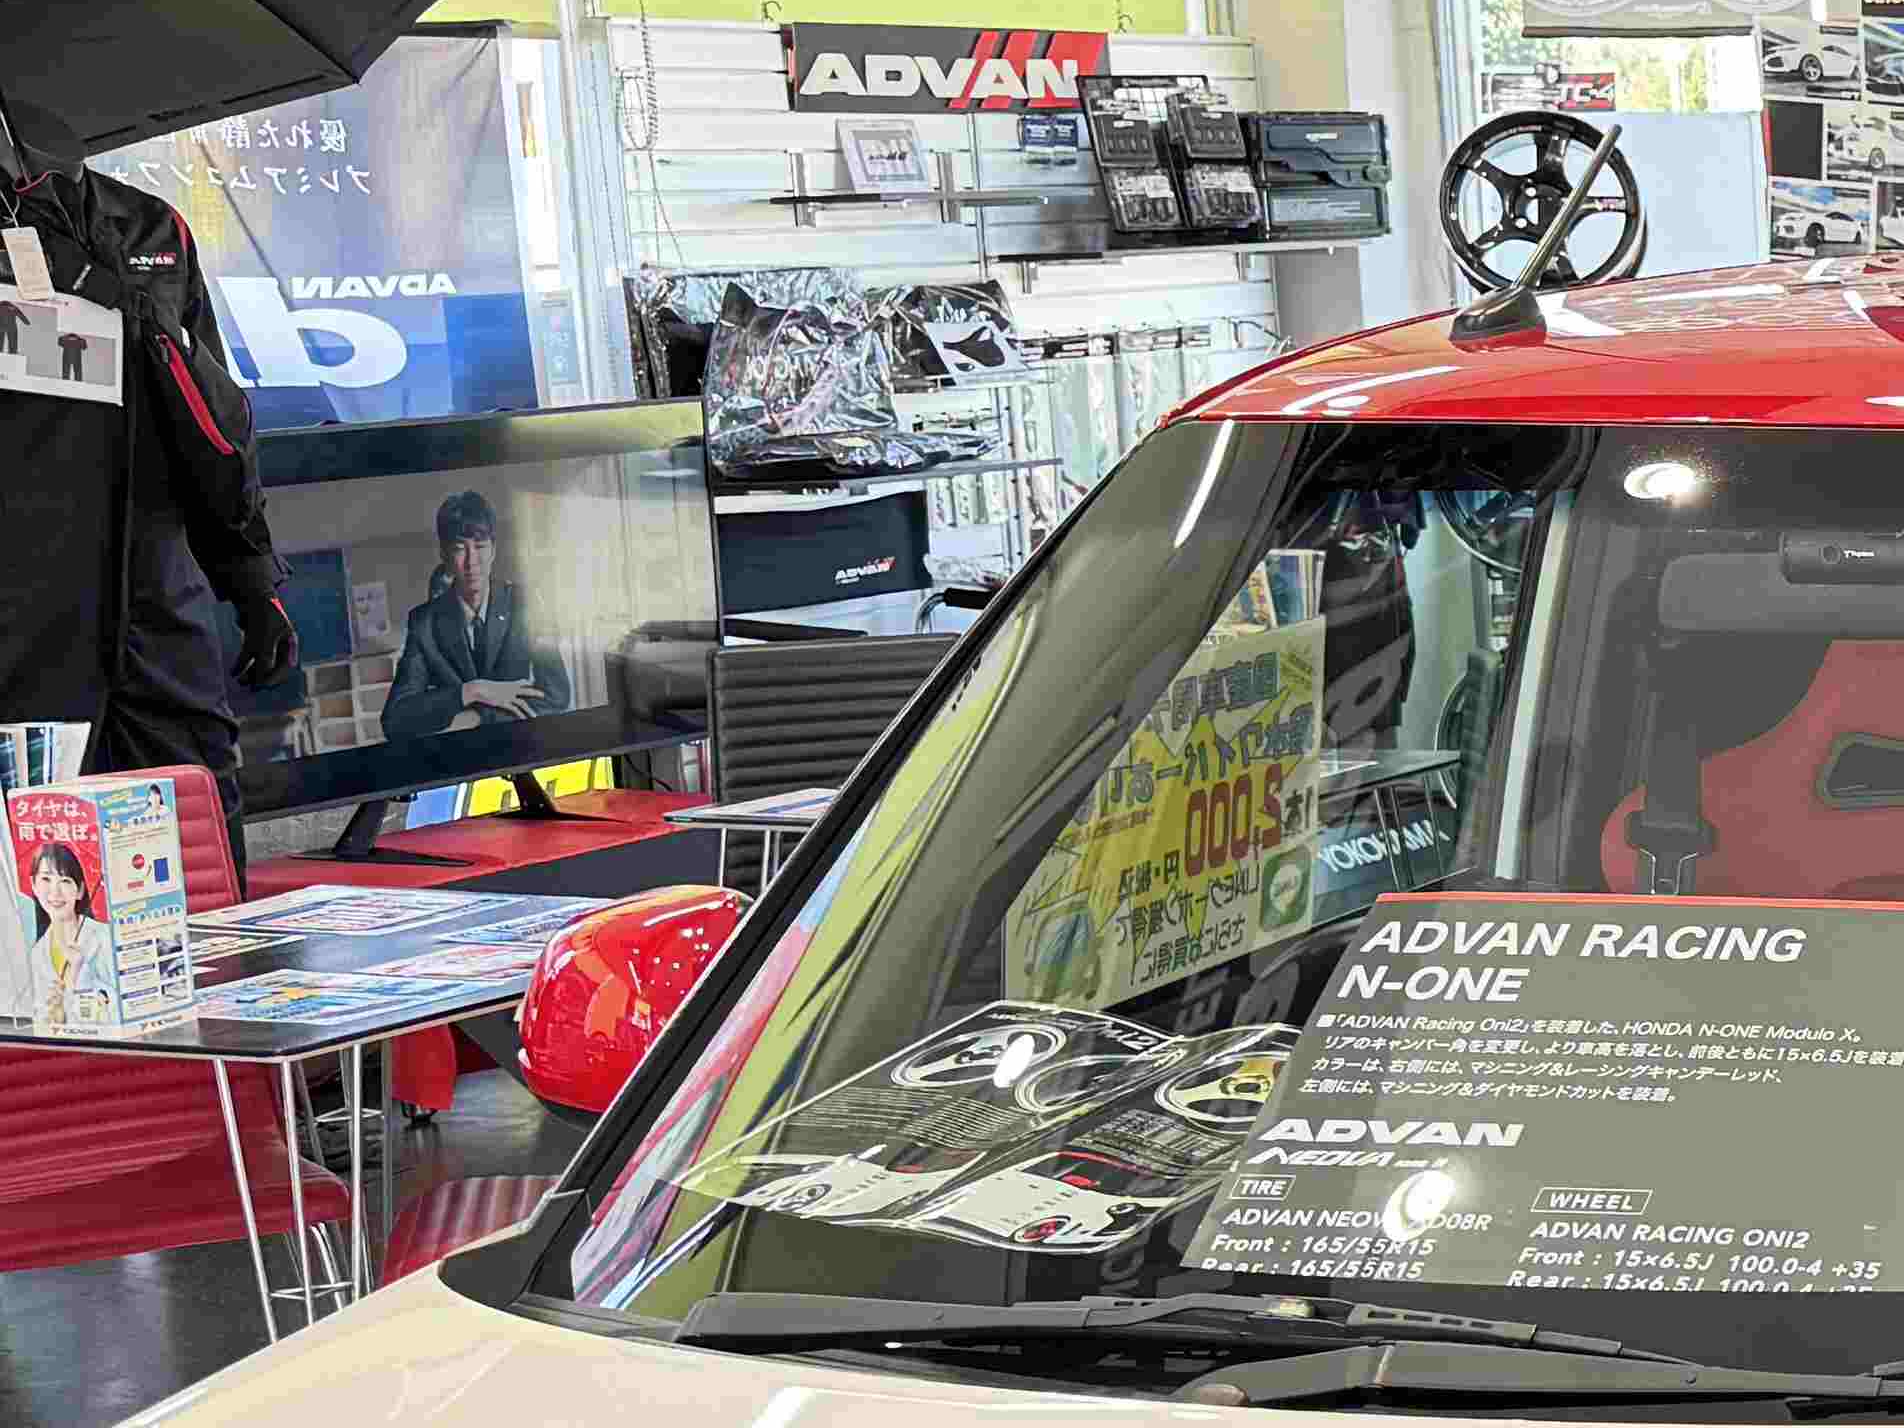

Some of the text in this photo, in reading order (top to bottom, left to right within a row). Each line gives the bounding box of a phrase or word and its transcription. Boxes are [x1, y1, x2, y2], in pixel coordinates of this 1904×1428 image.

[799, 52, 1079, 99] ADVAN
[1359, 920, 1809, 963] ADVAN RACING
[1337, 963, 1531, 1003] N-ONE
[1412, 1016, 1475, 1034] Racing
[1256, 1117, 1526, 1148] ADVAN
[1239, 1178, 1288, 1196] TIRE
[1547, 1192, 1635, 1212] WHEEL
[1222, 1209, 1315, 1228] ADVAN
[1210, 1233, 1438, 1256] Front 165/55R15
[1528, 1220, 1811, 1249] ADVAN RACING ONI2
[1518, 1246, 1586, 1266] Front
[1830, 1260, 1883, 1280] +35
[1504, 1269, 1577, 1290] Rear
